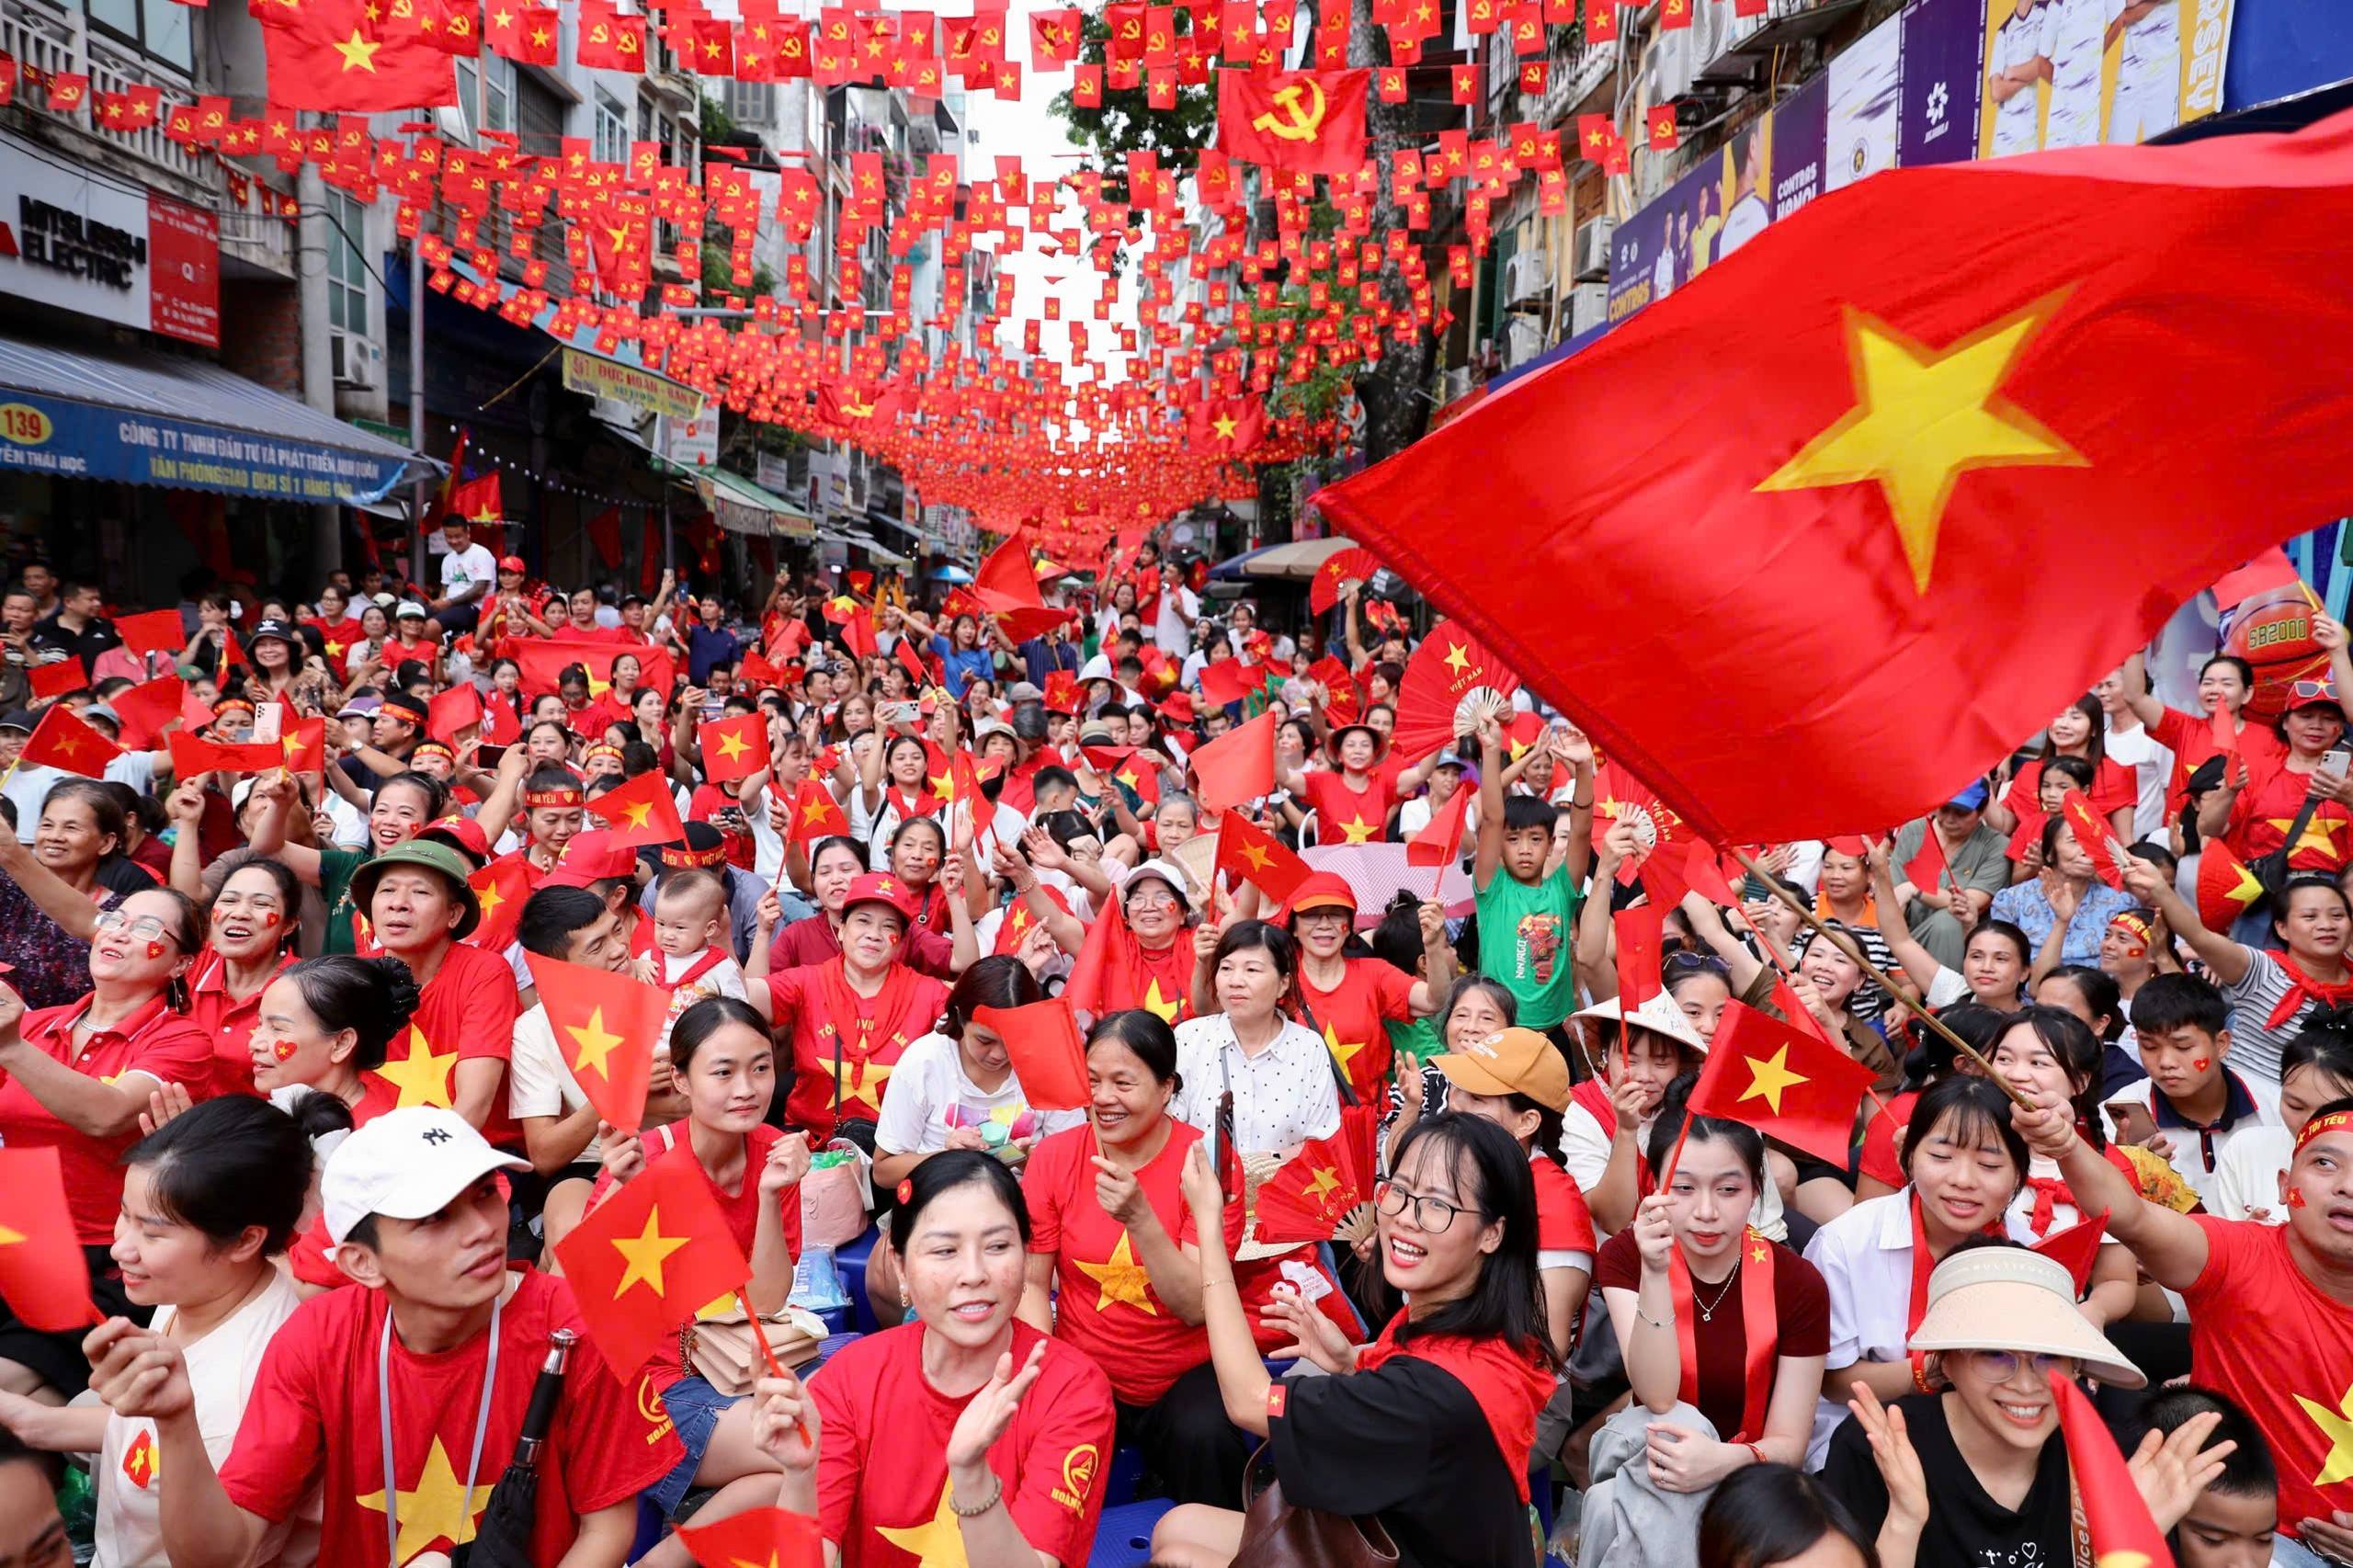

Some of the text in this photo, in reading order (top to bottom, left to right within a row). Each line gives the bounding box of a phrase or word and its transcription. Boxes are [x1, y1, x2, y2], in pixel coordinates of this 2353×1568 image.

[4, 408, 42, 439] 139
[119, 420, 158, 448] CÔNG
[162, 429, 177, 449] TY
[2248, 617, 2308, 651] SB2000
[2324, 1114, 2347, 1127] YÊU
